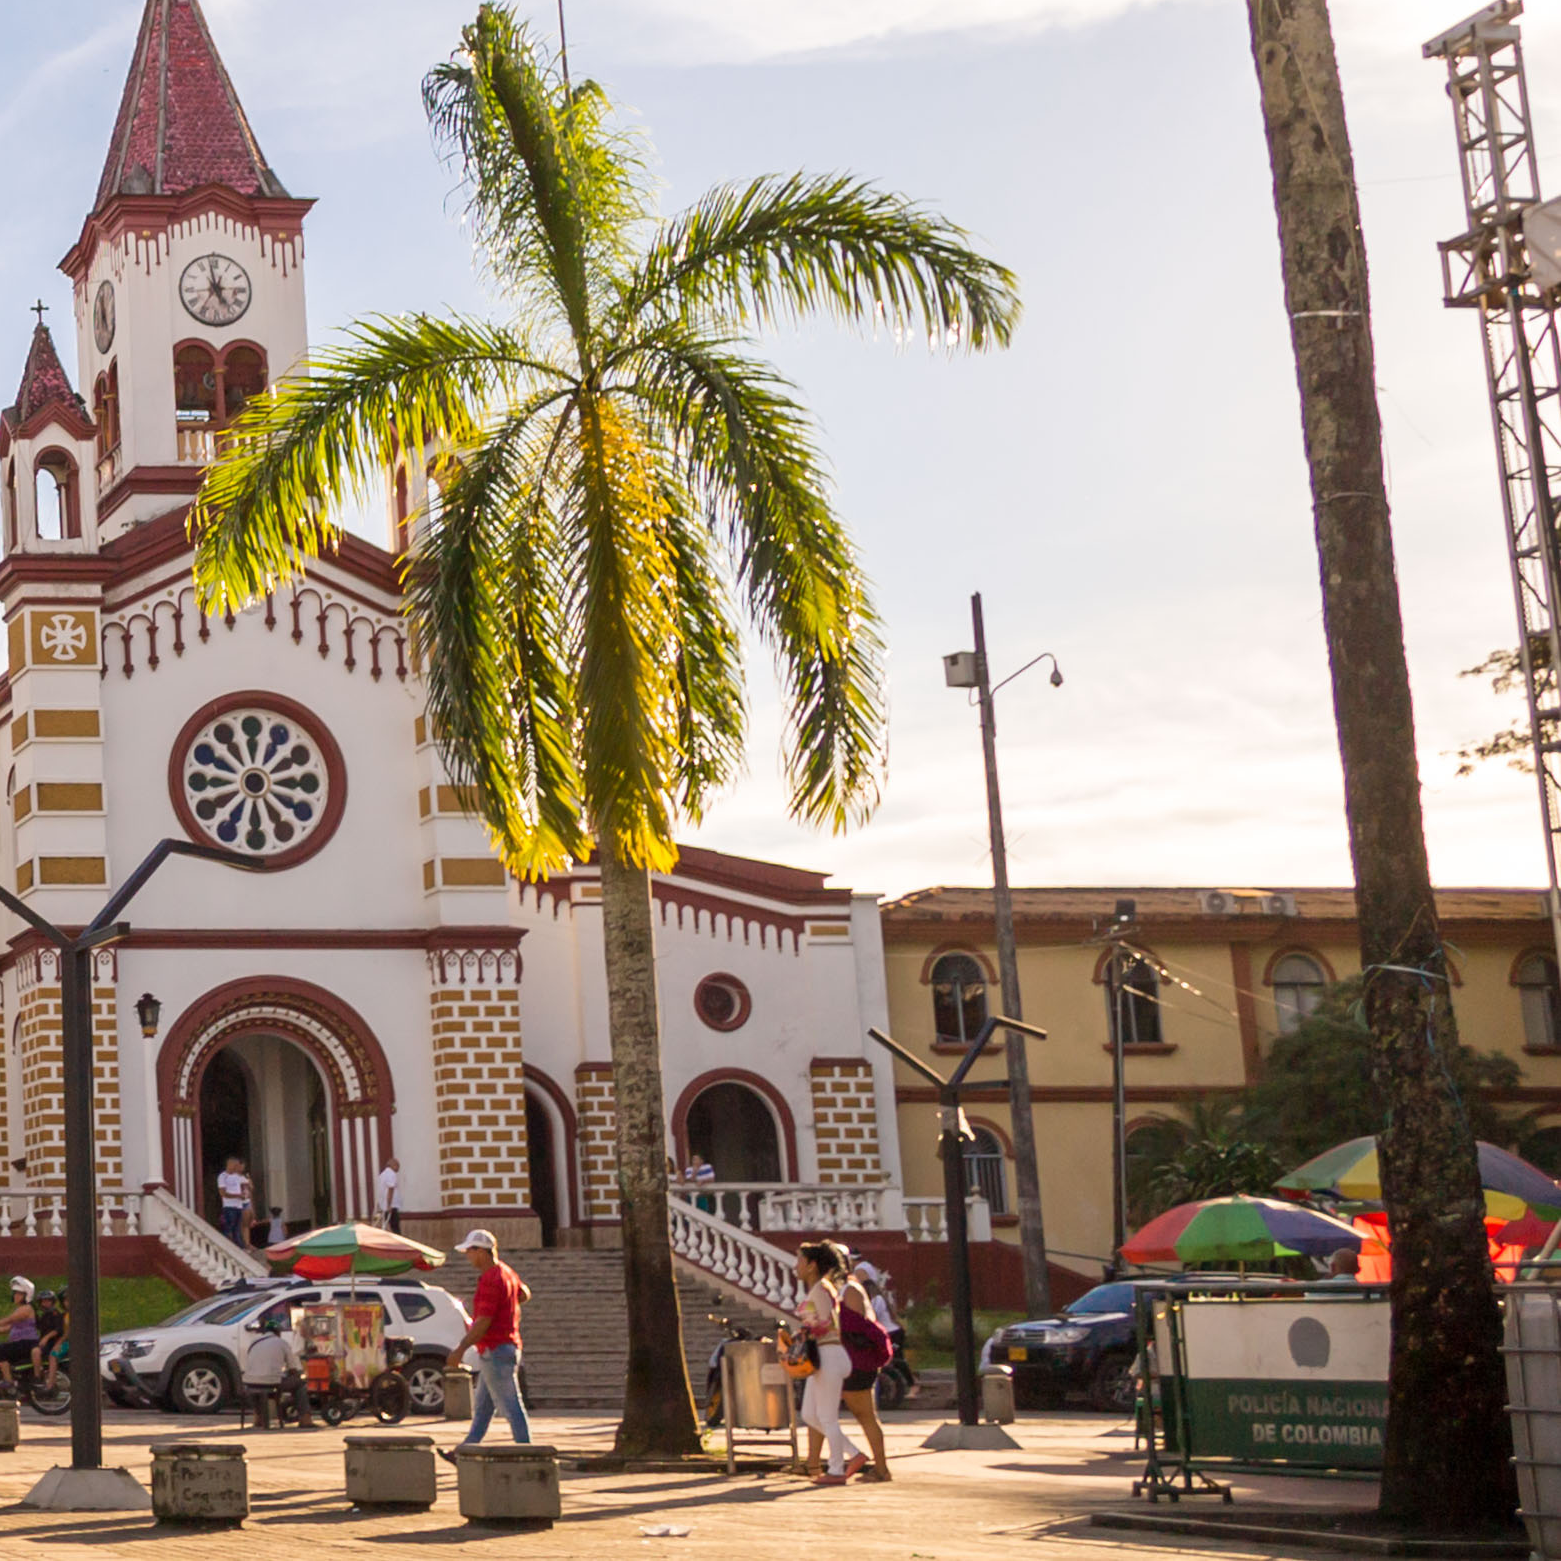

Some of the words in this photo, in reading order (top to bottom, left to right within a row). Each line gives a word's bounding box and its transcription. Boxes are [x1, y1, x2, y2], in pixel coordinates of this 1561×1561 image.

[1228, 1390, 1301, 1414] POLICÍA
[1252, 1423, 1276, 1443] DE
[1282, 1424, 1382, 1446] COLOMBIA
